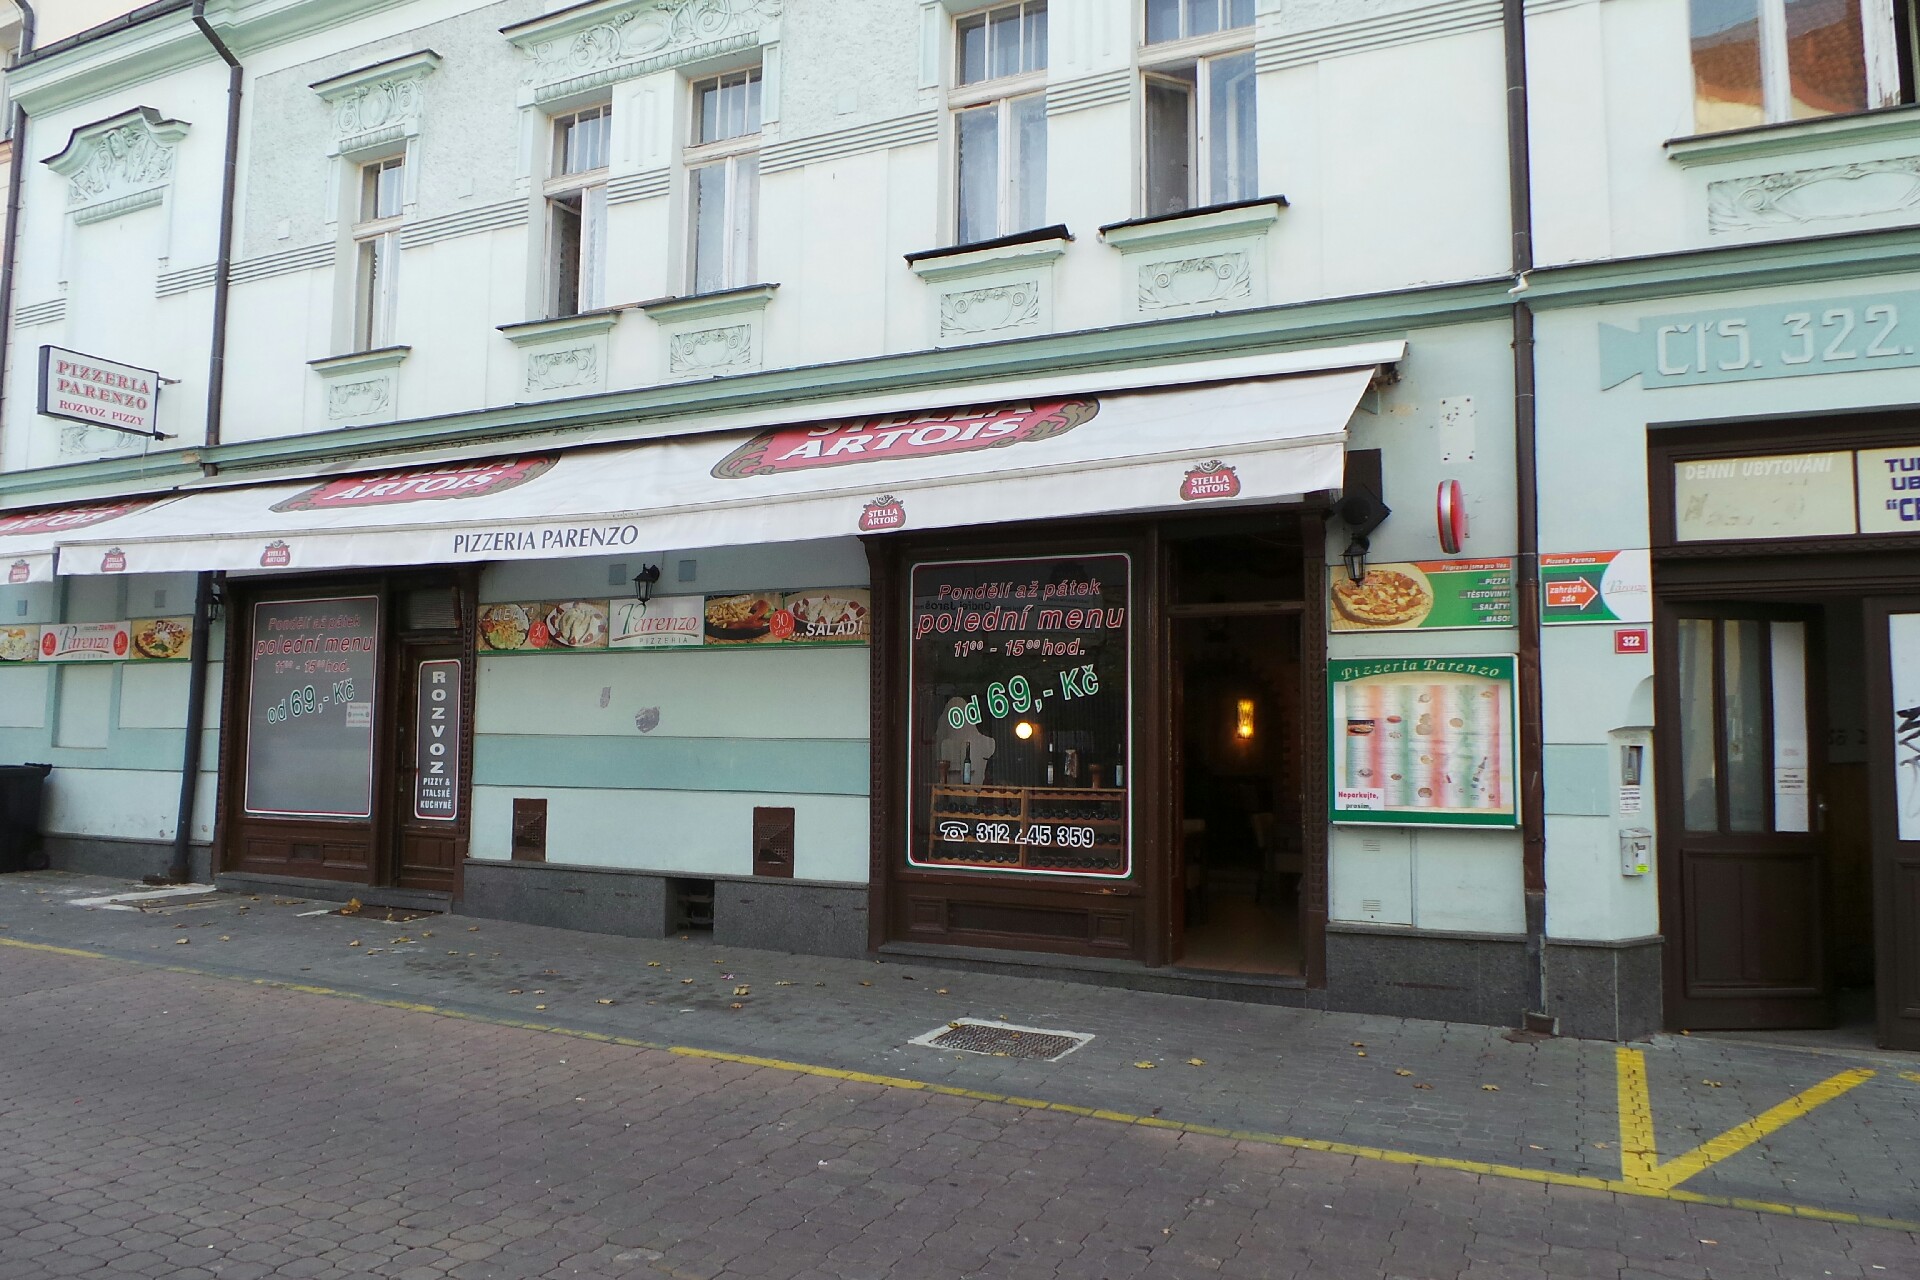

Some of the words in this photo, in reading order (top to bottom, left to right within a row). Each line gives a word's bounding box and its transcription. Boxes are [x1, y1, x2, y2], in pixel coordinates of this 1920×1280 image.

[1780, 304, 1914, 366] 322.
[57, 360, 151, 395] PIZZERIA
[57, 378, 148, 411] PARENZO
[59, 400, 106, 418] ROZVOZ
[112, 411, 145, 426] PIZZY
[775, 417, 1025, 461] ARTOIS
[1685, 459, 1736, 481] DENNÍ
[1741, 452, 1834, 478] UBYTOVÁNÍ
[1884, 457, 1920, 473] TU
[323, 470, 504, 500] ARTOIS
[1191, 474, 1230, 486] STELLA
[1191, 483, 1230, 495] ARTOIS
[867, 515, 898, 526] ARTOIS
[868, 508, 898, 518] STELLA
[453, 531, 536, 554] PIZZERIA
[541, 525, 639, 548] PARENZO
[938, 581, 1013, 601] Pondělí
[1015, 580, 1039, 598] až
[1043, 578, 1101, 601] pátek
[1550, 585, 1587, 594] zahrádka
[156, 622, 185, 632] PIZZA
[268, 615, 312, 631] Pondělí
[313, 615, 327, 629] až
[327, 613, 361, 630] pátek
[618, 603, 700, 634] Parenzo
[773, 612, 789, 629] 30
[916, 605, 1034, 639] polední
[1037, 607, 1125, 629] menu
[60, 626, 109, 651] Parenzo
[533, 623, 546, 638] 30
[1622, 636, 1640, 647] 322
[255, 633, 323, 660] polední
[324, 636, 373, 653] menu
[1041, 638, 1086, 655] hod.
[1341, 660, 1418, 680] Pizzeria
[1423, 659, 1500, 677] Parenzo
[267, 699, 287, 724] od
[289, 684, 330, 718] 69,-
[333, 678, 355, 704] Kč
[948, 695, 982, 729] od
[987, 675, 1054, 719] 69,-
[1060, 664, 1099, 700] Kč
[429, 671, 446, 774] ROZVOZ
[422, 788, 451, 798] ITALSKÉ
[423, 777, 443, 786] PIZZY
[445, 778, 451, 786] &
[1338, 791, 1379, 800] Neparkujte,
[976, 822, 1010, 844] 312
[1057, 826, 1095, 848] 359
